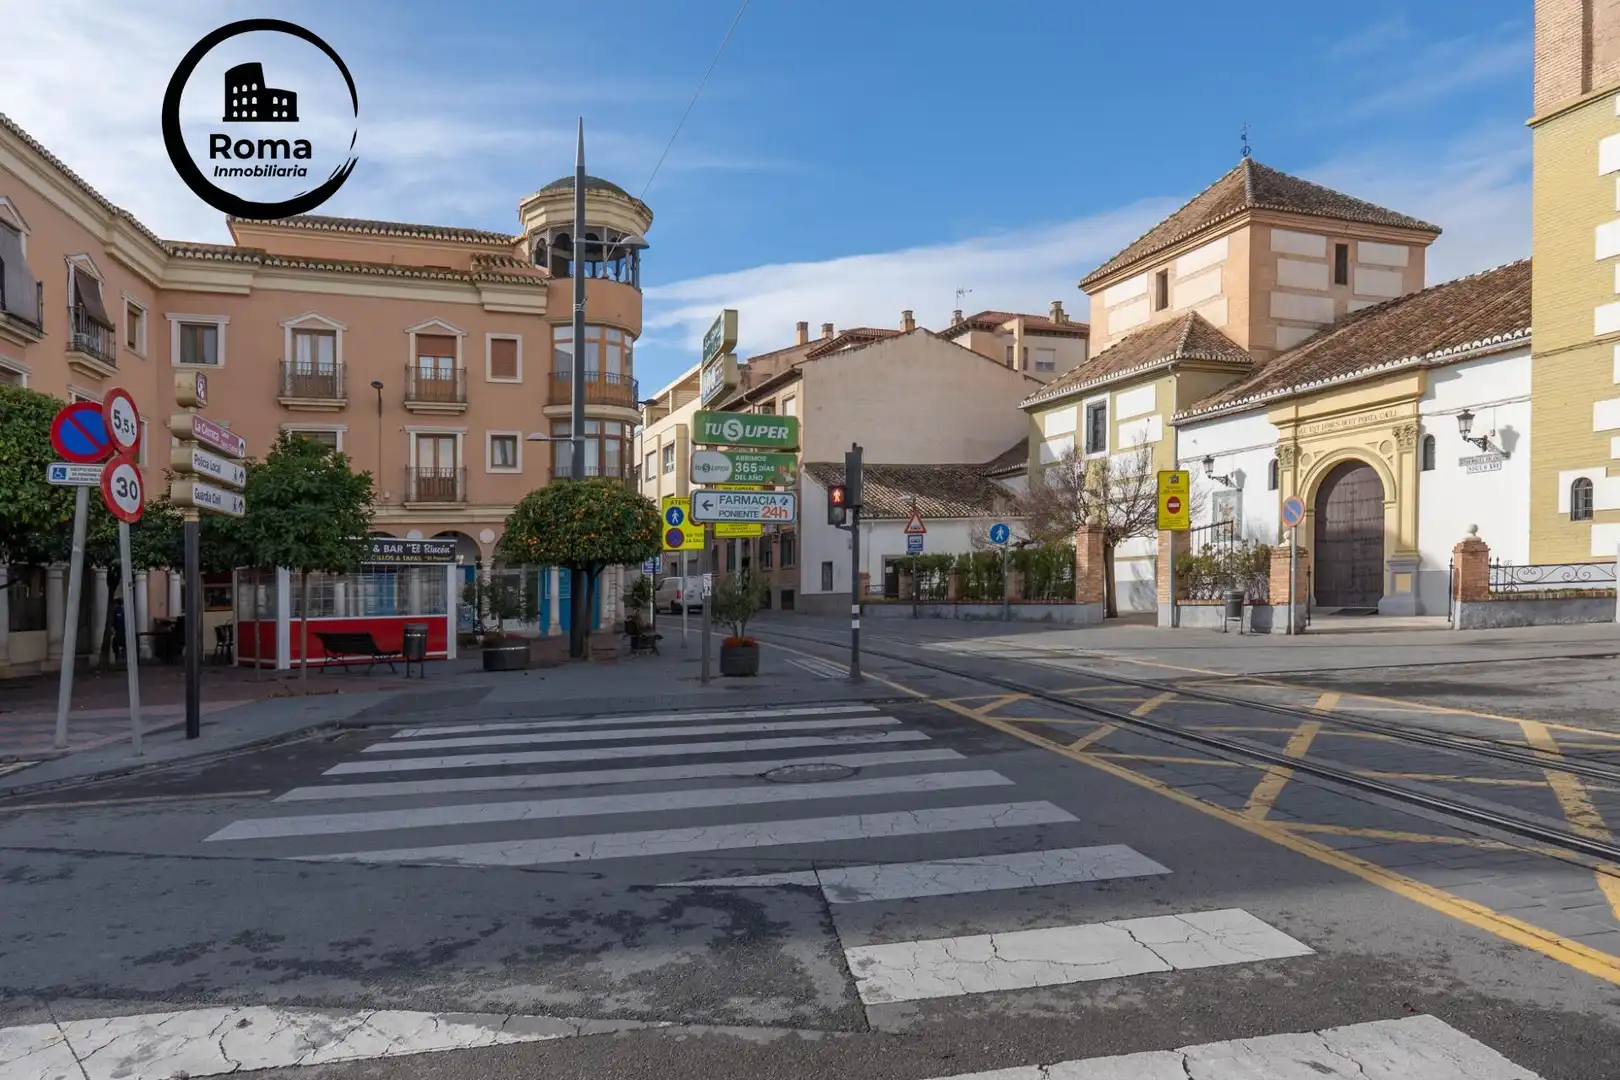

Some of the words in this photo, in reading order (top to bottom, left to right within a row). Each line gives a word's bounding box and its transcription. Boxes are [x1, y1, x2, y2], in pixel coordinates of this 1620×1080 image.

[194, 419, 201, 433] La
[735, 454, 767, 462] ABRIMOS
[209, 460, 221, 474] Local
[735, 462, 758, 473] 365
[758, 464, 775, 472] DÍAS
[747, 473, 764, 481] AÑO
[116, 476, 138, 500] 30
[194, 487, 212, 503] Guardia
[212, 492, 222, 505] Civil
[719, 495, 777, 506] FARMACIA
[718, 510, 759, 519] PONIENTE
[761, 505, 789, 519] 24h
[372, 544, 380, 553] &
[383, 544, 404, 553] BAR
